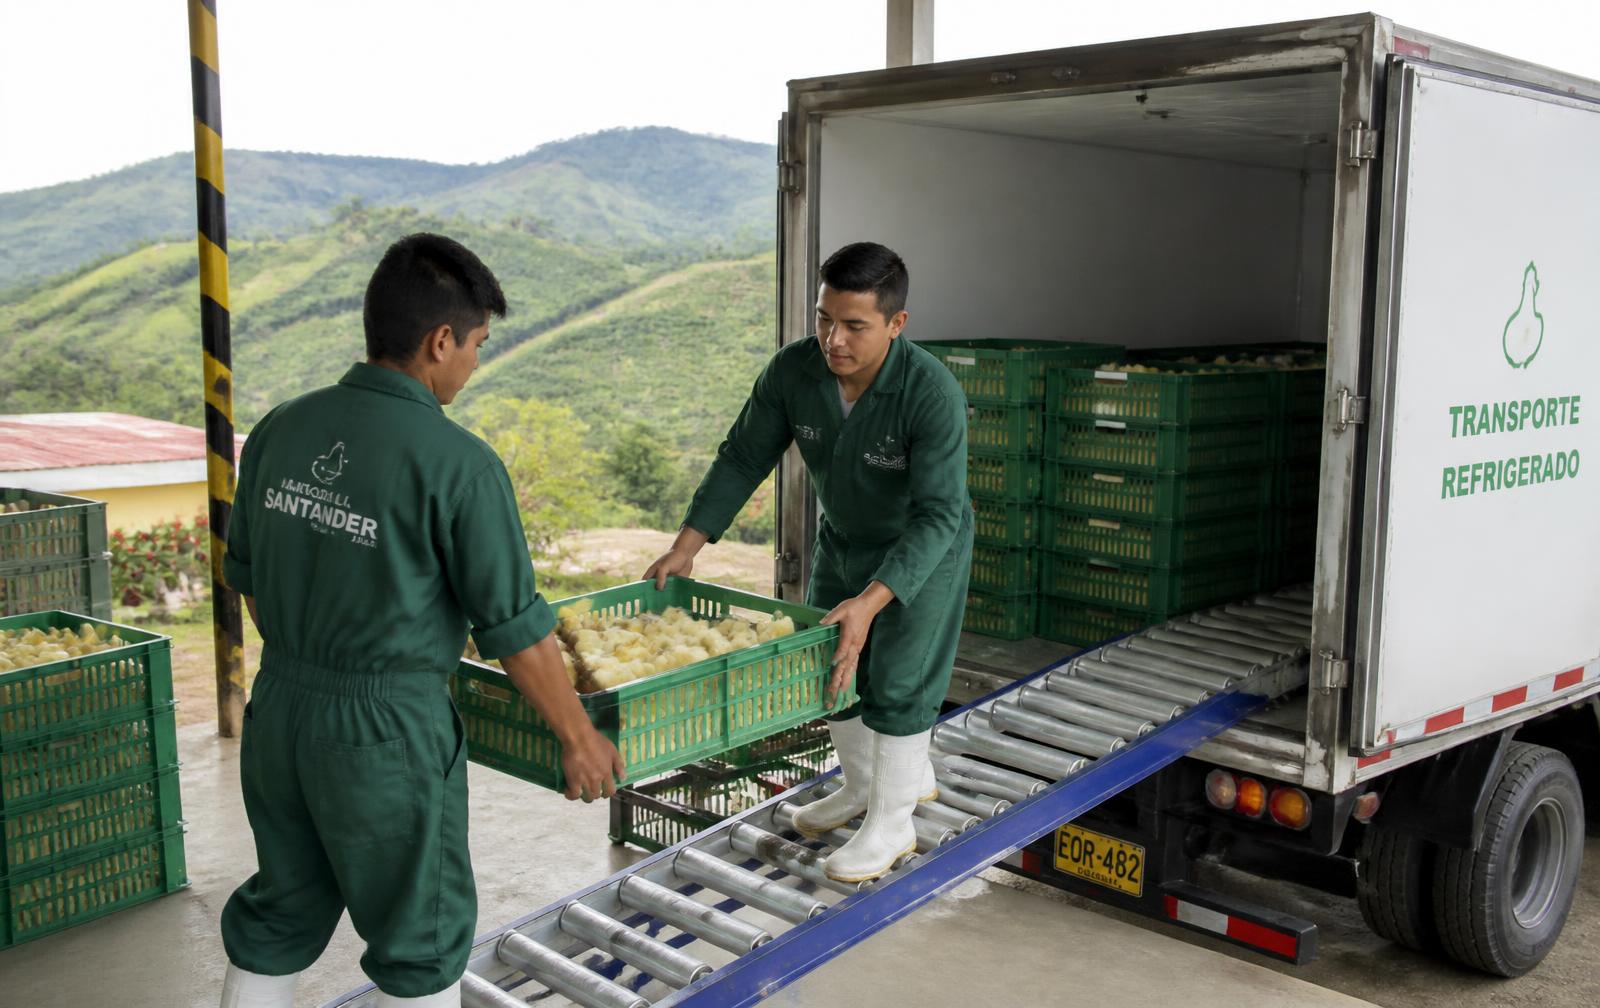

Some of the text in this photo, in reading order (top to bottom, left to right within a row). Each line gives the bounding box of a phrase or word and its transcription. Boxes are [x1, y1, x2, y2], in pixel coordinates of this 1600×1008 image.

[1449, 395, 1581, 438] TRANSPORTE
[1441, 449, 1580, 499] REFRIGERADO
[264, 487, 378, 540] SANTANDER
[1058, 830, 1140, 884] EOR-482
